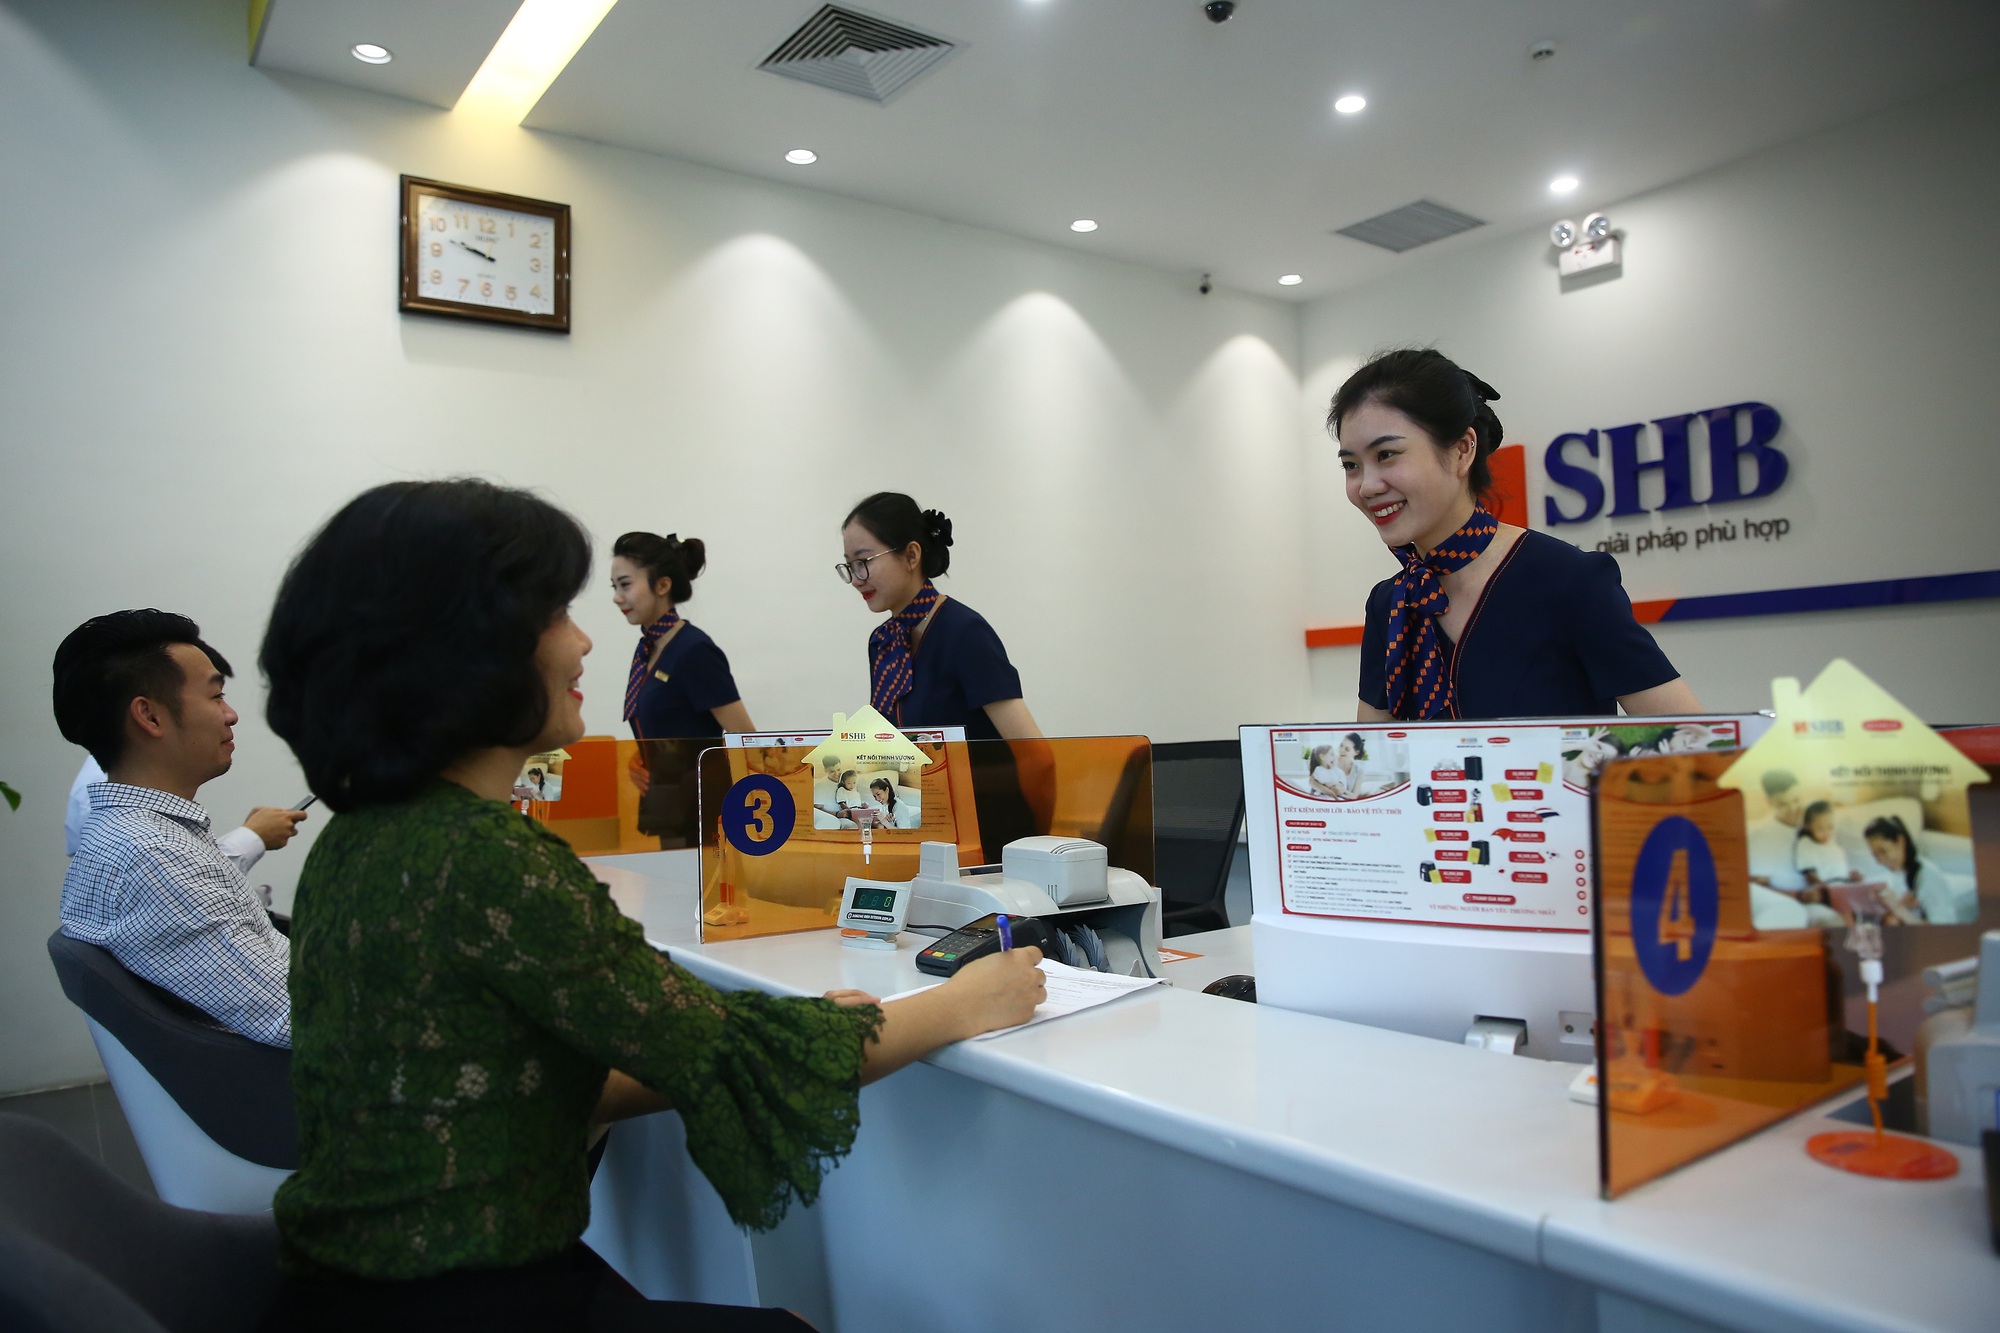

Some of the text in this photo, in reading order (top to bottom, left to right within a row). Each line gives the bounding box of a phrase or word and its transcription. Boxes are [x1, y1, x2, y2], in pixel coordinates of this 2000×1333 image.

[430, 217, 446, 233] 10
[454, 213, 469, 230] 11
[479, 218, 496, 234] 12
[507, 222, 514, 237] 1
[530, 234, 541, 249] 2
[431, 243, 442, 258] 9
[530, 259, 541, 273] 3
[431, 271, 442, 285] 8
[458, 279, 469, 294] 7
[481, 283, 492, 297] 6
[506, 287, 516, 300] 5
[530, 285, 541, 298] 4
[1544, 402, 1789, 526] SHB
[1636, 526, 1688, 556] pháp
[1695, 519, 1736, 550] phù
[1744, 518, 1790, 541] hợp
[848, 732, 866, 740] SHB
[744, 788, 775, 843] 3
[1658, 848, 1696, 963] 4
